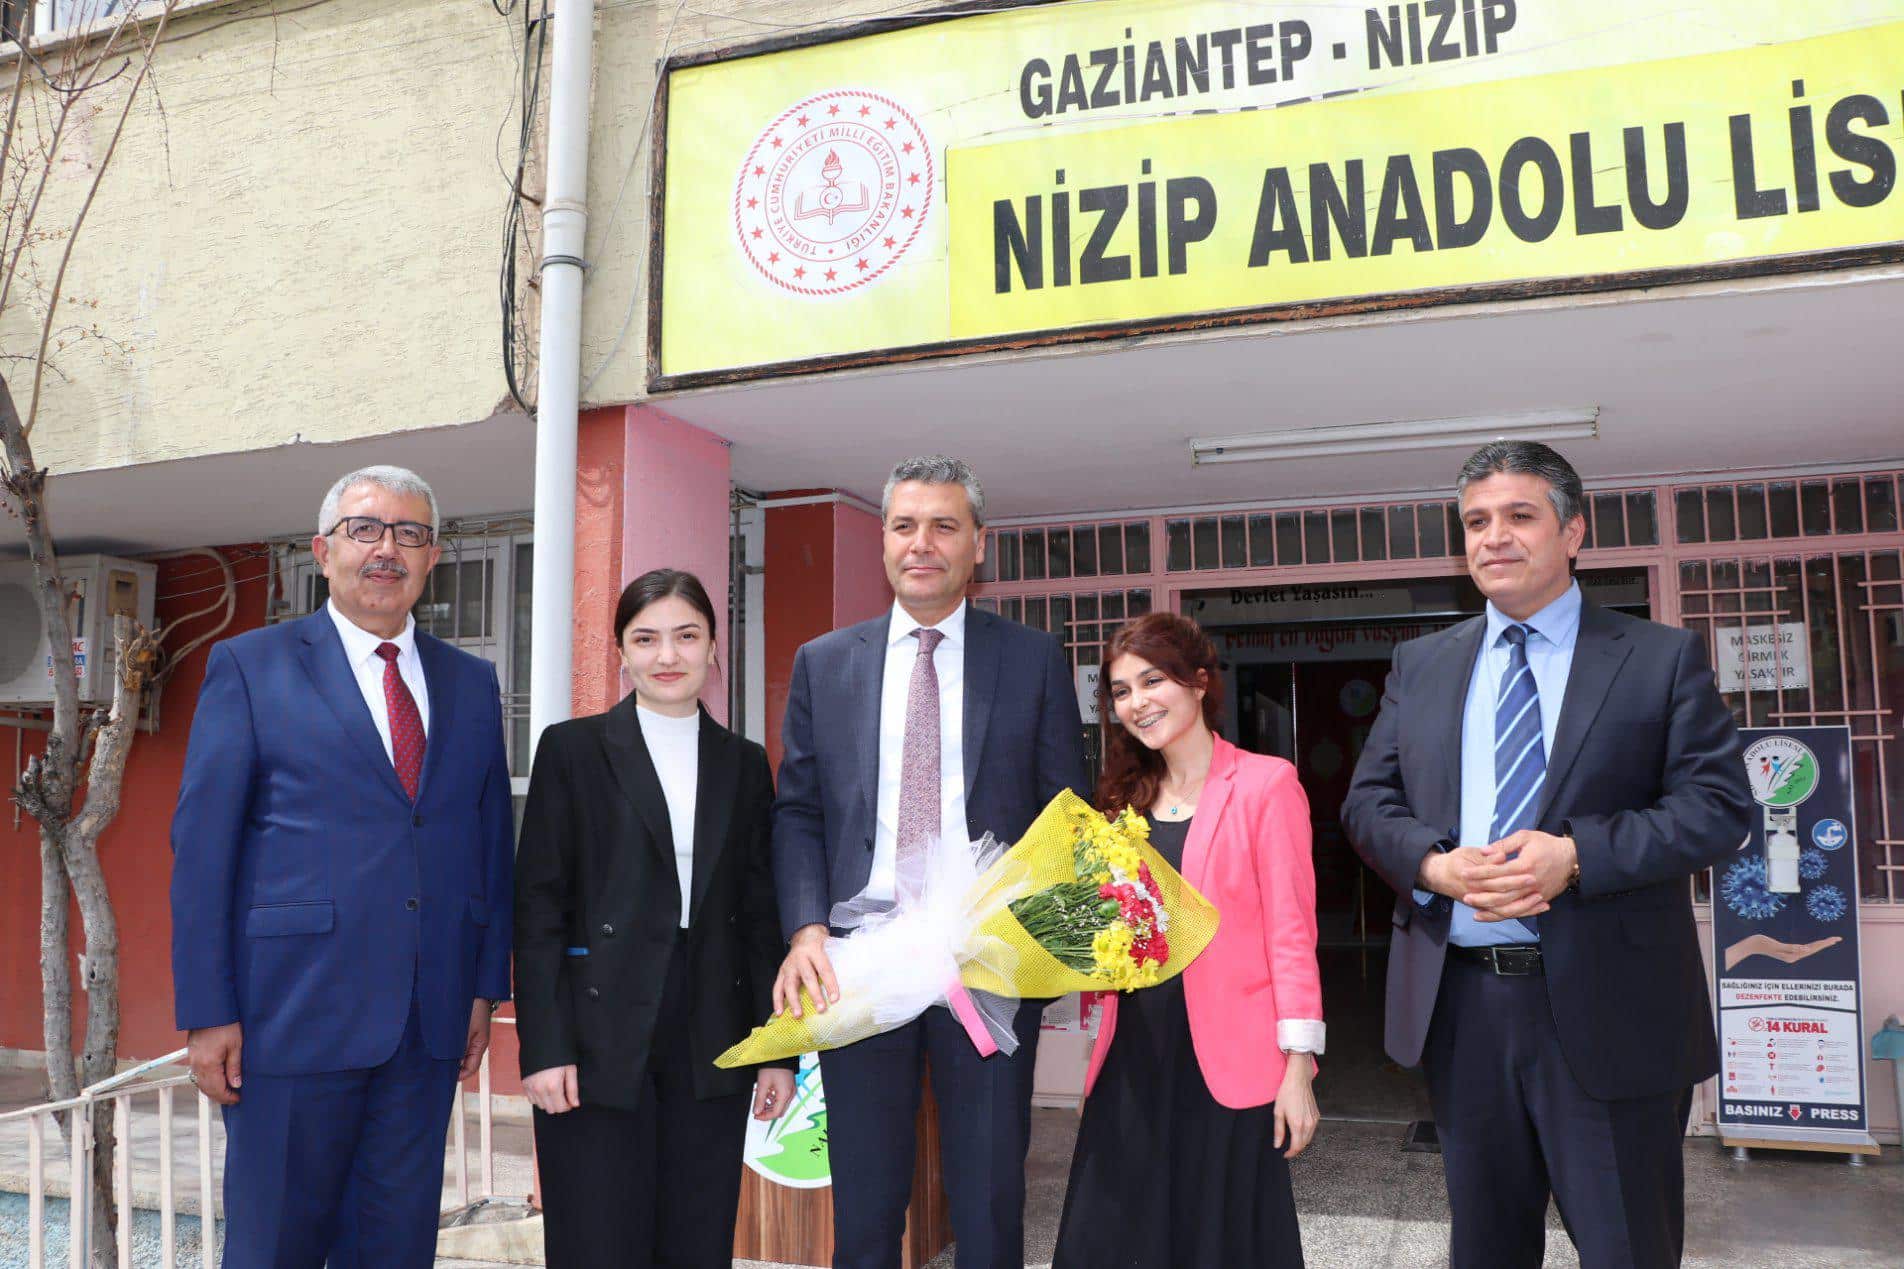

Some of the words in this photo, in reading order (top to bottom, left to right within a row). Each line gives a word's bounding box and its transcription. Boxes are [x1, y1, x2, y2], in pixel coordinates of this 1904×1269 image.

[1020, 20, 1312, 119] GAZİANTEP
[993, 158, 1218, 294] NİZİP
[1247, 121, 1689, 268] ANADOLU
[1729, 79, 1904, 220] LİS
[1766, 1021, 1780, 1033] 14
[1783, 1021, 1828, 1034] KURAL
[1725, 1104, 1784, 1118] BASINIZ
[1810, 1107, 1859, 1121] PRESS
